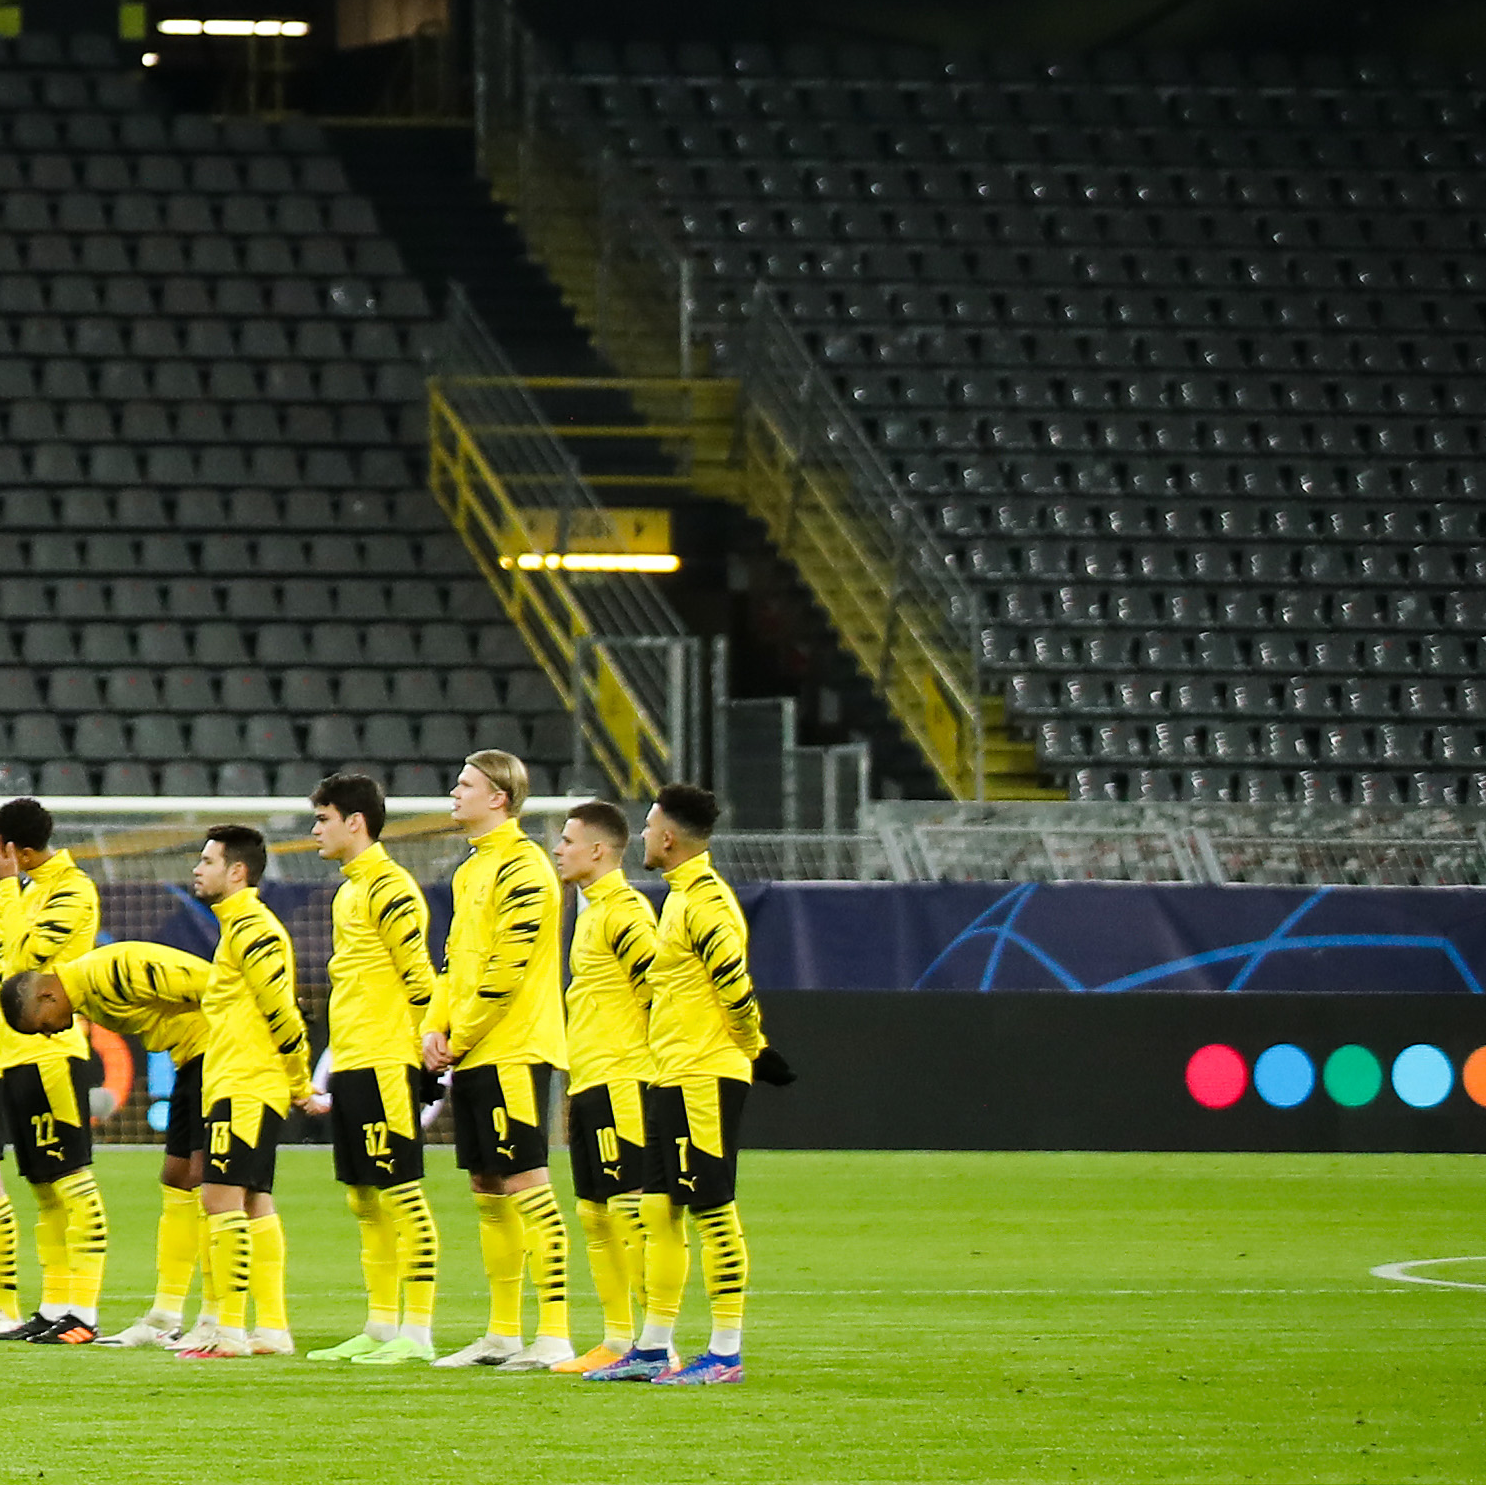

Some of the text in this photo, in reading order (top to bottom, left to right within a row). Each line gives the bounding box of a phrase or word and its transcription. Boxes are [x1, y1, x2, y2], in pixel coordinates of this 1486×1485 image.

[30, 1111, 60, 1147] 22
[210, 1121, 231, 1155] 13
[362, 1121, 392, 1157] 32
[492, 1106, 509, 1141] 9
[596, 1126, 620, 1163] 10
[675, 1136, 689, 1173] 7
